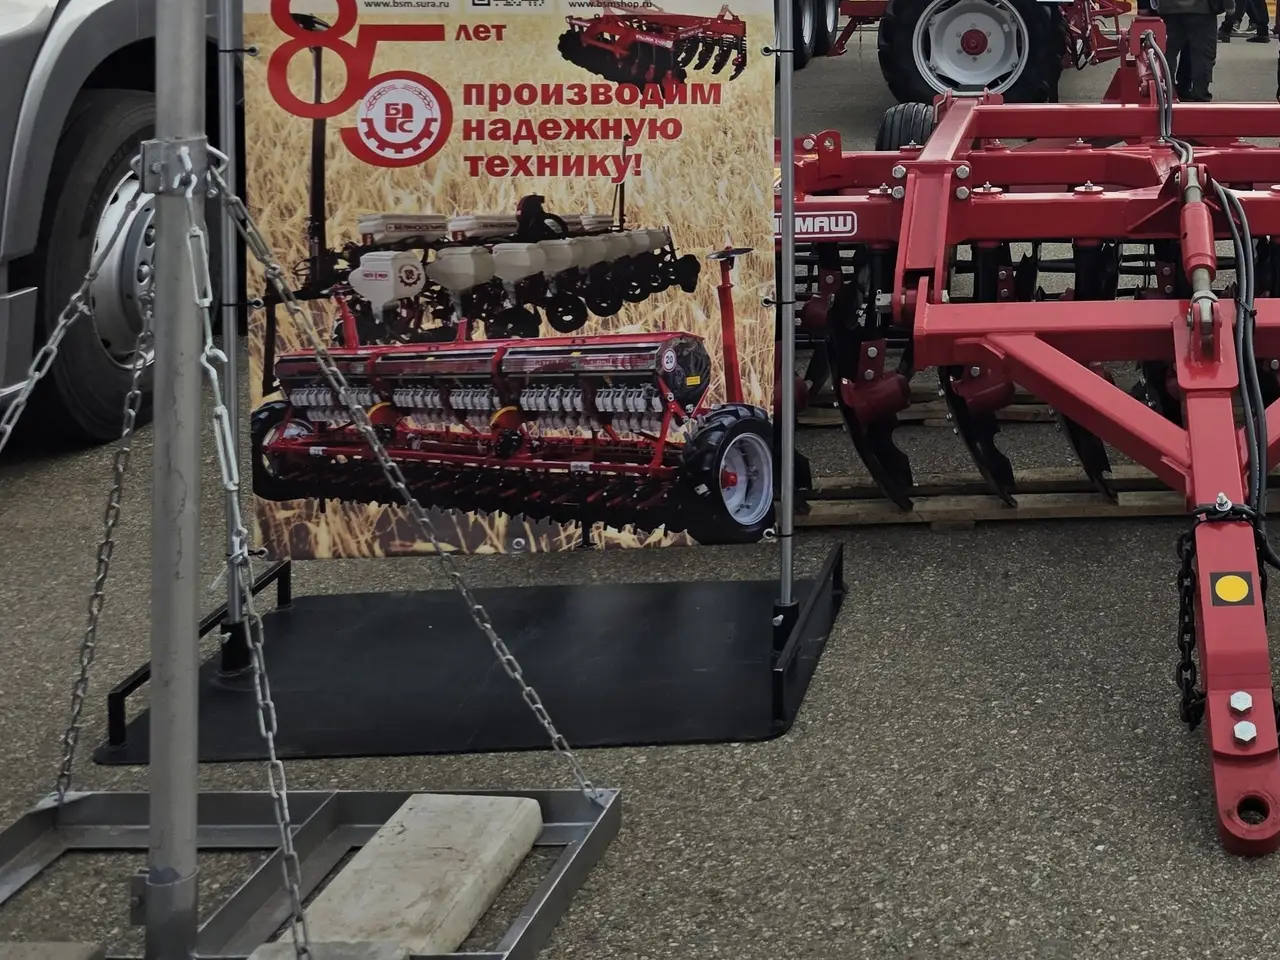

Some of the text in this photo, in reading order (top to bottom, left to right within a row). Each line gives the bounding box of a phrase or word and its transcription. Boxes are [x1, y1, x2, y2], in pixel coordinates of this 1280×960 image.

[454, 23, 508, 42] лет
[463, 83, 722, 107] производим
[462, 118, 682, 144] надежную
[464, 154, 642, 182] технику!
[664, 355, 674, 365] 20
